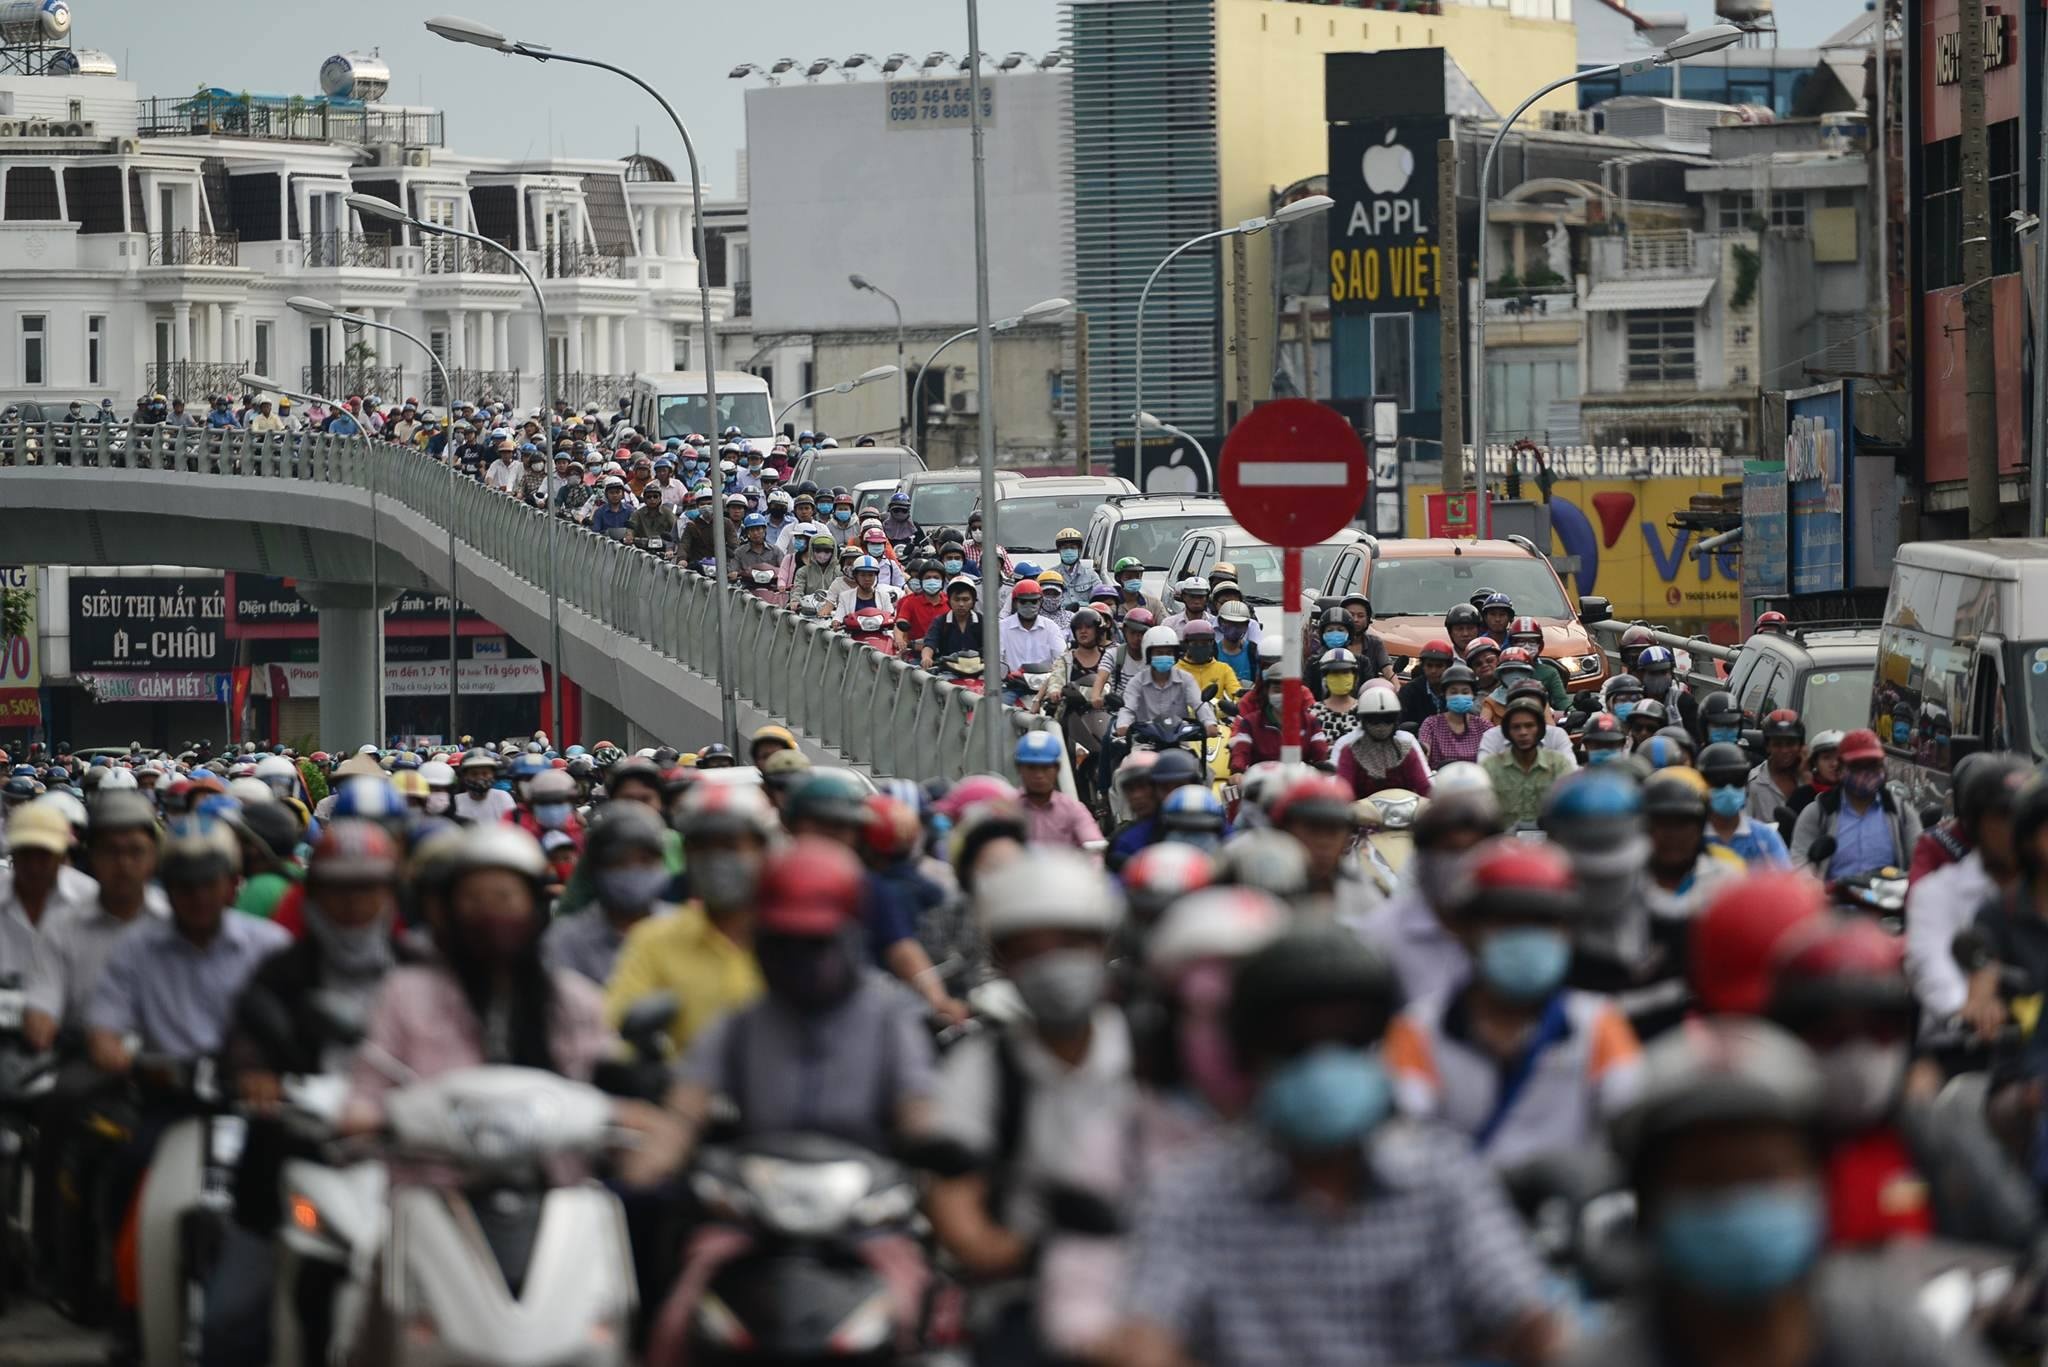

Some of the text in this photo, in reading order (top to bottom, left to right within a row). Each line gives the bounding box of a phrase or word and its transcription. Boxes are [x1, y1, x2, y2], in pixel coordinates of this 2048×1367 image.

[1936, 32, 1960, 86] NGUY
[890, 90, 917, 105] 090
[890, 105, 917, 121] 090
[1330, 248, 1380, 302] SAO
[81, 588, 122, 618] SIÊU
[124, 595, 155, 622] THỊ
[159, 584, 196, 618] MẮT
[239, 599, 266, 618] Điện
[269, 599, 301, 617] thoại
[152, 625, 216, 658] CHÂU
[475, 642, 502, 653] DELL
[290, 668, 319, 680] iPhon
[422, 666, 436, 677] 1.7
[501, 664, 520, 678] góp
[138, 672, 174, 697] GIẢM
[177, 671, 201, 697] HẾT
